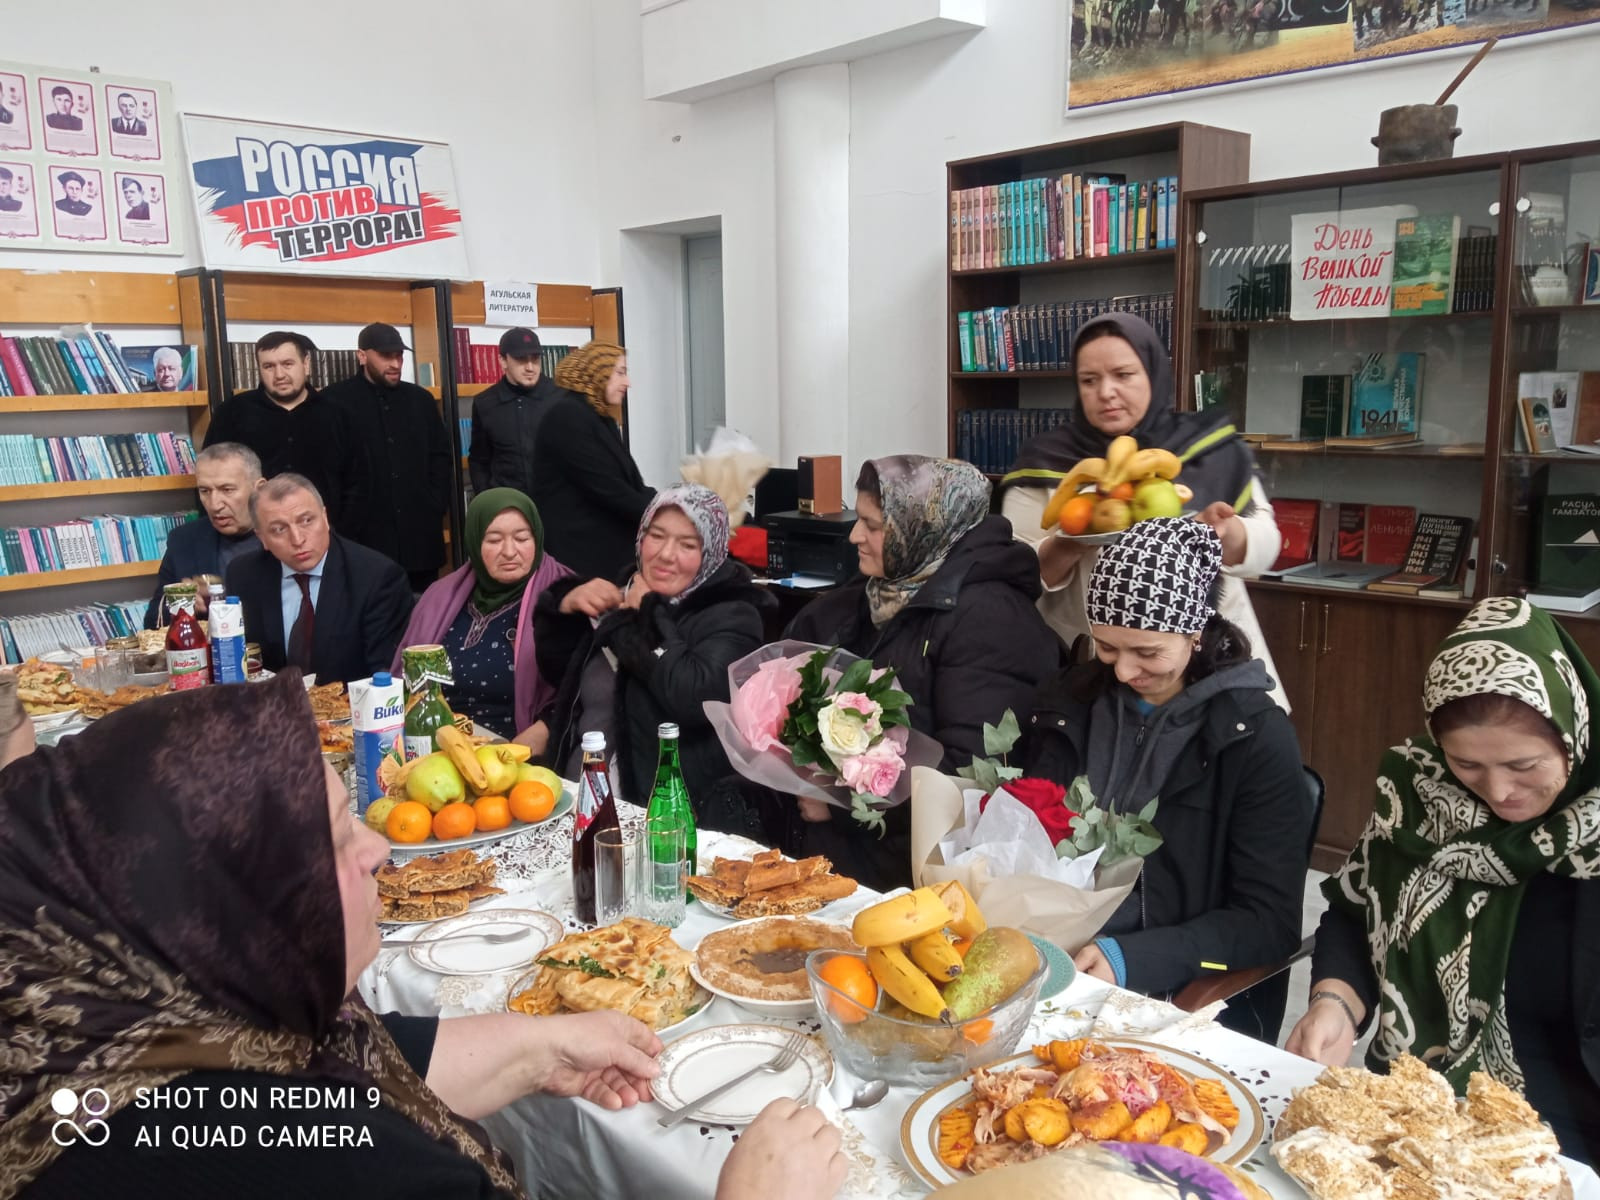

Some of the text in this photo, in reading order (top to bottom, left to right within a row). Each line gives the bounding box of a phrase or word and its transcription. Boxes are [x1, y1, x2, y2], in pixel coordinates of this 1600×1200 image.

[236, 137, 420, 206] РОССИЯ
[246, 186, 377, 230] ПРОТИВ
[274, 210, 423, 260] ТЕРРОРА!
[1314, 223, 1374, 251] День
[1301, 250, 1392, 281] Великой
[489, 303, 534, 313] ЛИТЕРАТУРА
[490, 289, 531, 300] АГУЛЬСКАЯ
[1361, 409, 1398, 429] 1941
[1561, 500, 1595, 510] РАСУЛ
